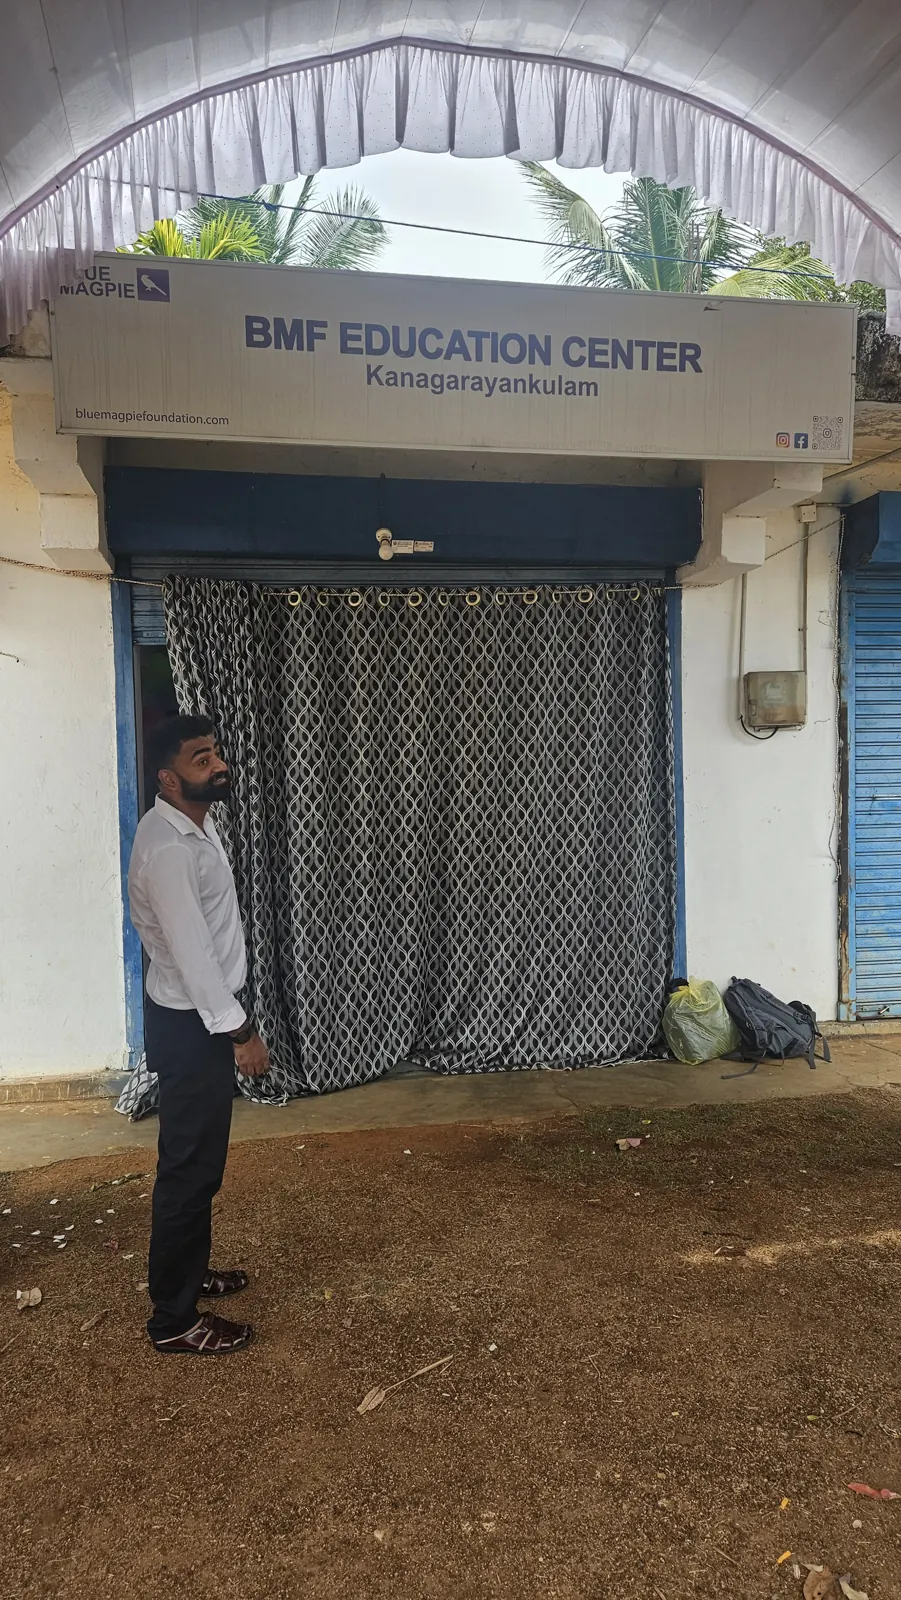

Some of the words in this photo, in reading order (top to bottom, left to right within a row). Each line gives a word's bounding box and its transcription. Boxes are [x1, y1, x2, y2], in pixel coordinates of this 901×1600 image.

[84, 265, 111, 282] UE
[60, 281, 135, 299] MAGPIE
[245, 315, 328, 352] BMF
[339, 322, 552, 366] EDUCATION
[562, 336, 703, 373] CENTER
[366, 364, 599, 398] Kanagarayankulam
[75, 408, 229, 425] bluemagpiefoundation.com
